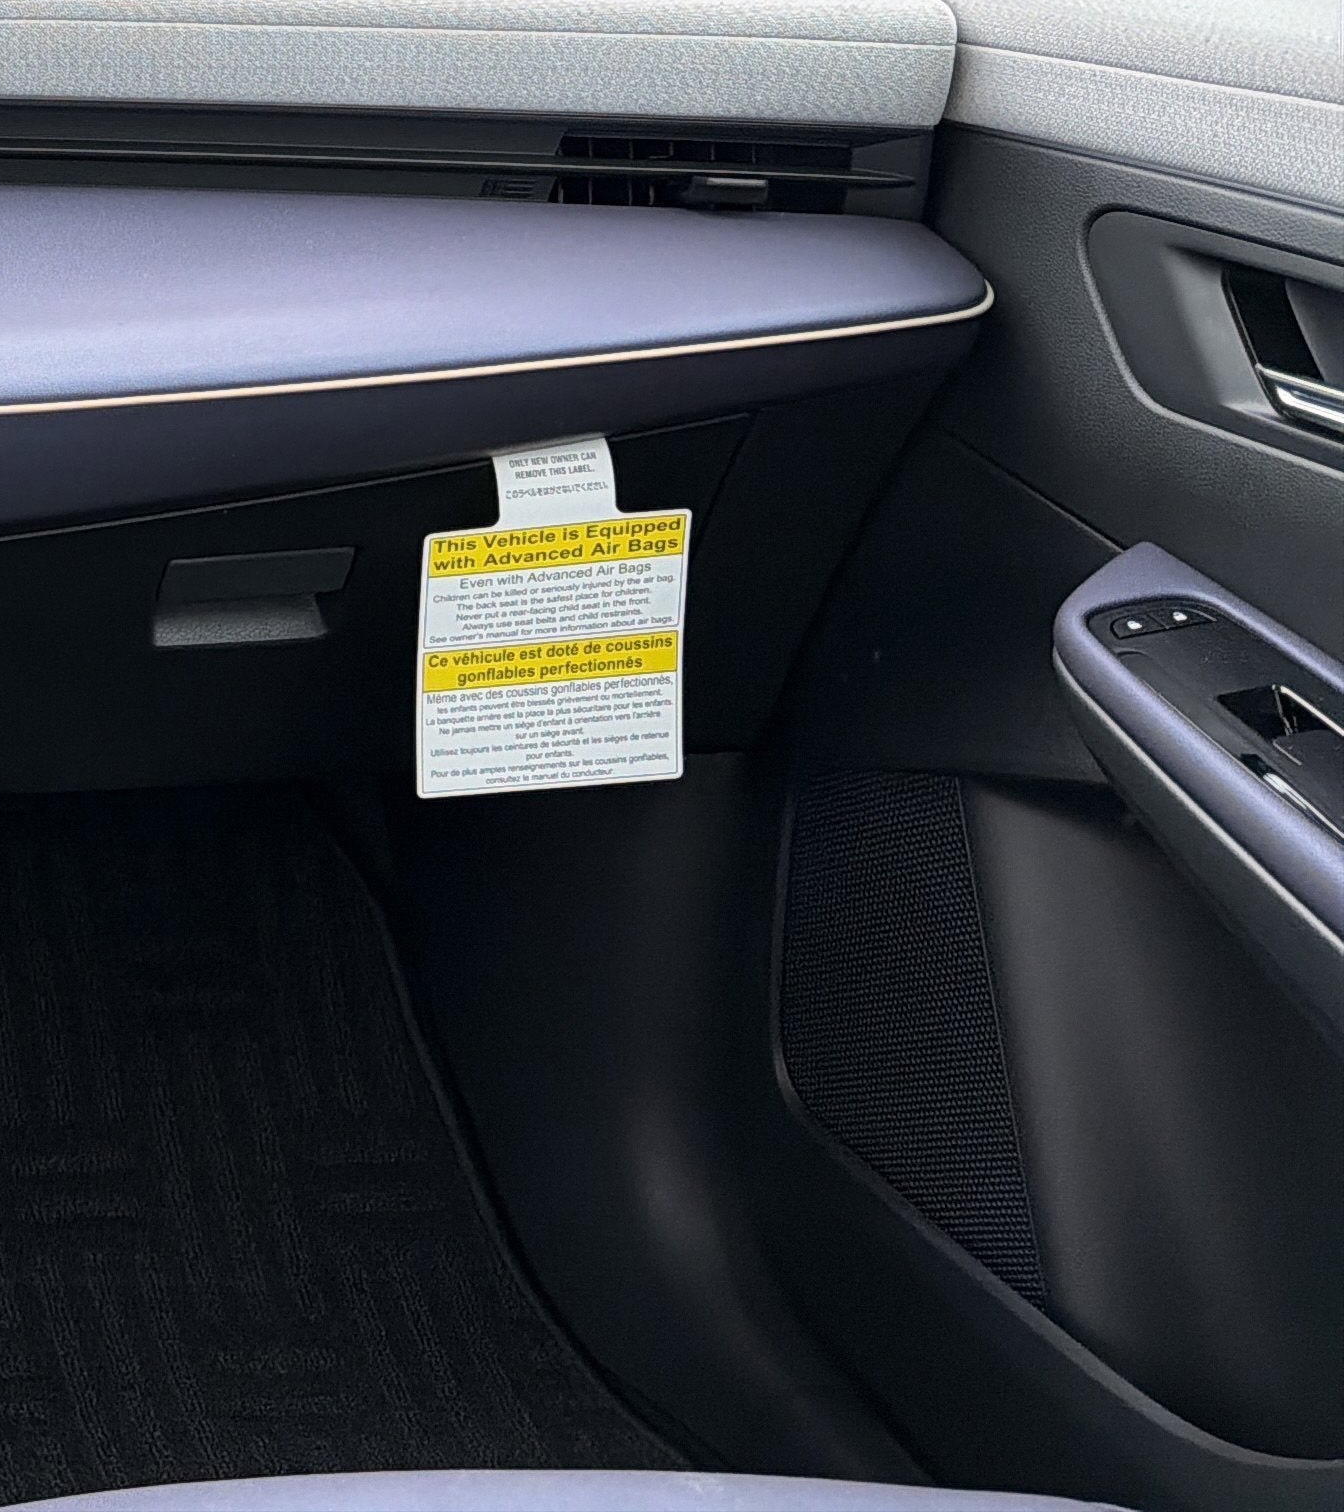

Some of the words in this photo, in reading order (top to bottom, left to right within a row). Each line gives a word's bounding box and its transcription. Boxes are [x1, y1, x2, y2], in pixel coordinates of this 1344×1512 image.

[509, 459, 529, 468] ONLY
[531, 456, 548, 465] NEW
[551, 454, 579, 464] OWNER
[581, 452, 596, 460] CAN
[515, 469, 547, 479] REMOVE
[549, 467, 566, 475] THIS
[568, 464, 595, 474] LABEL.
[434, 538, 477, 553] This
[483, 531, 555, 548] Vehicle
[563, 528, 579, 540] is
[586, 518, 681, 539] Equipped
[434, 556, 475, 570] with
[484, 544, 583, 567] Advanced
[591, 542, 620, 556] Air
[628, 538, 678, 552] Bags
[433, 594, 470, 603] Children
[505, 588, 527, 596] killed
[541, 583, 580, 593] seriously
[583, 580, 611, 590] injured
[614, 579, 624, 587] by
[657, 574, 675, 582] bag.
[460, 578, 493, 588] Even
[497, 574, 523, 585] with
[527, 567, 593, 583] Advanced
[596, 566, 615, 576] Air
[619, 563, 651, 575] Bags
[476, 600, 496, 608] back
[500, 598, 518, 606] seat
[546, 594, 572, 603] safest
[575, 593, 598, 601] place
[615, 587, 652, 596] children.
[429, 655, 448, 667] Ce
[453, 649, 515, 665] véhicule
[520, 647, 542, 660] est
[547, 643, 578, 657] doté
[584, 642, 601, 654] de
[606, 636, 672, 652] coussins
[458, 666, 535, 686] gonflables
[539, 656, 642, 679] perfectionnés
[460, 692, 483, 702] avec
[486, 690, 503, 699] des
[506, 686, 548, 698] coussins
[551, 682, 601, 696] gonflables
